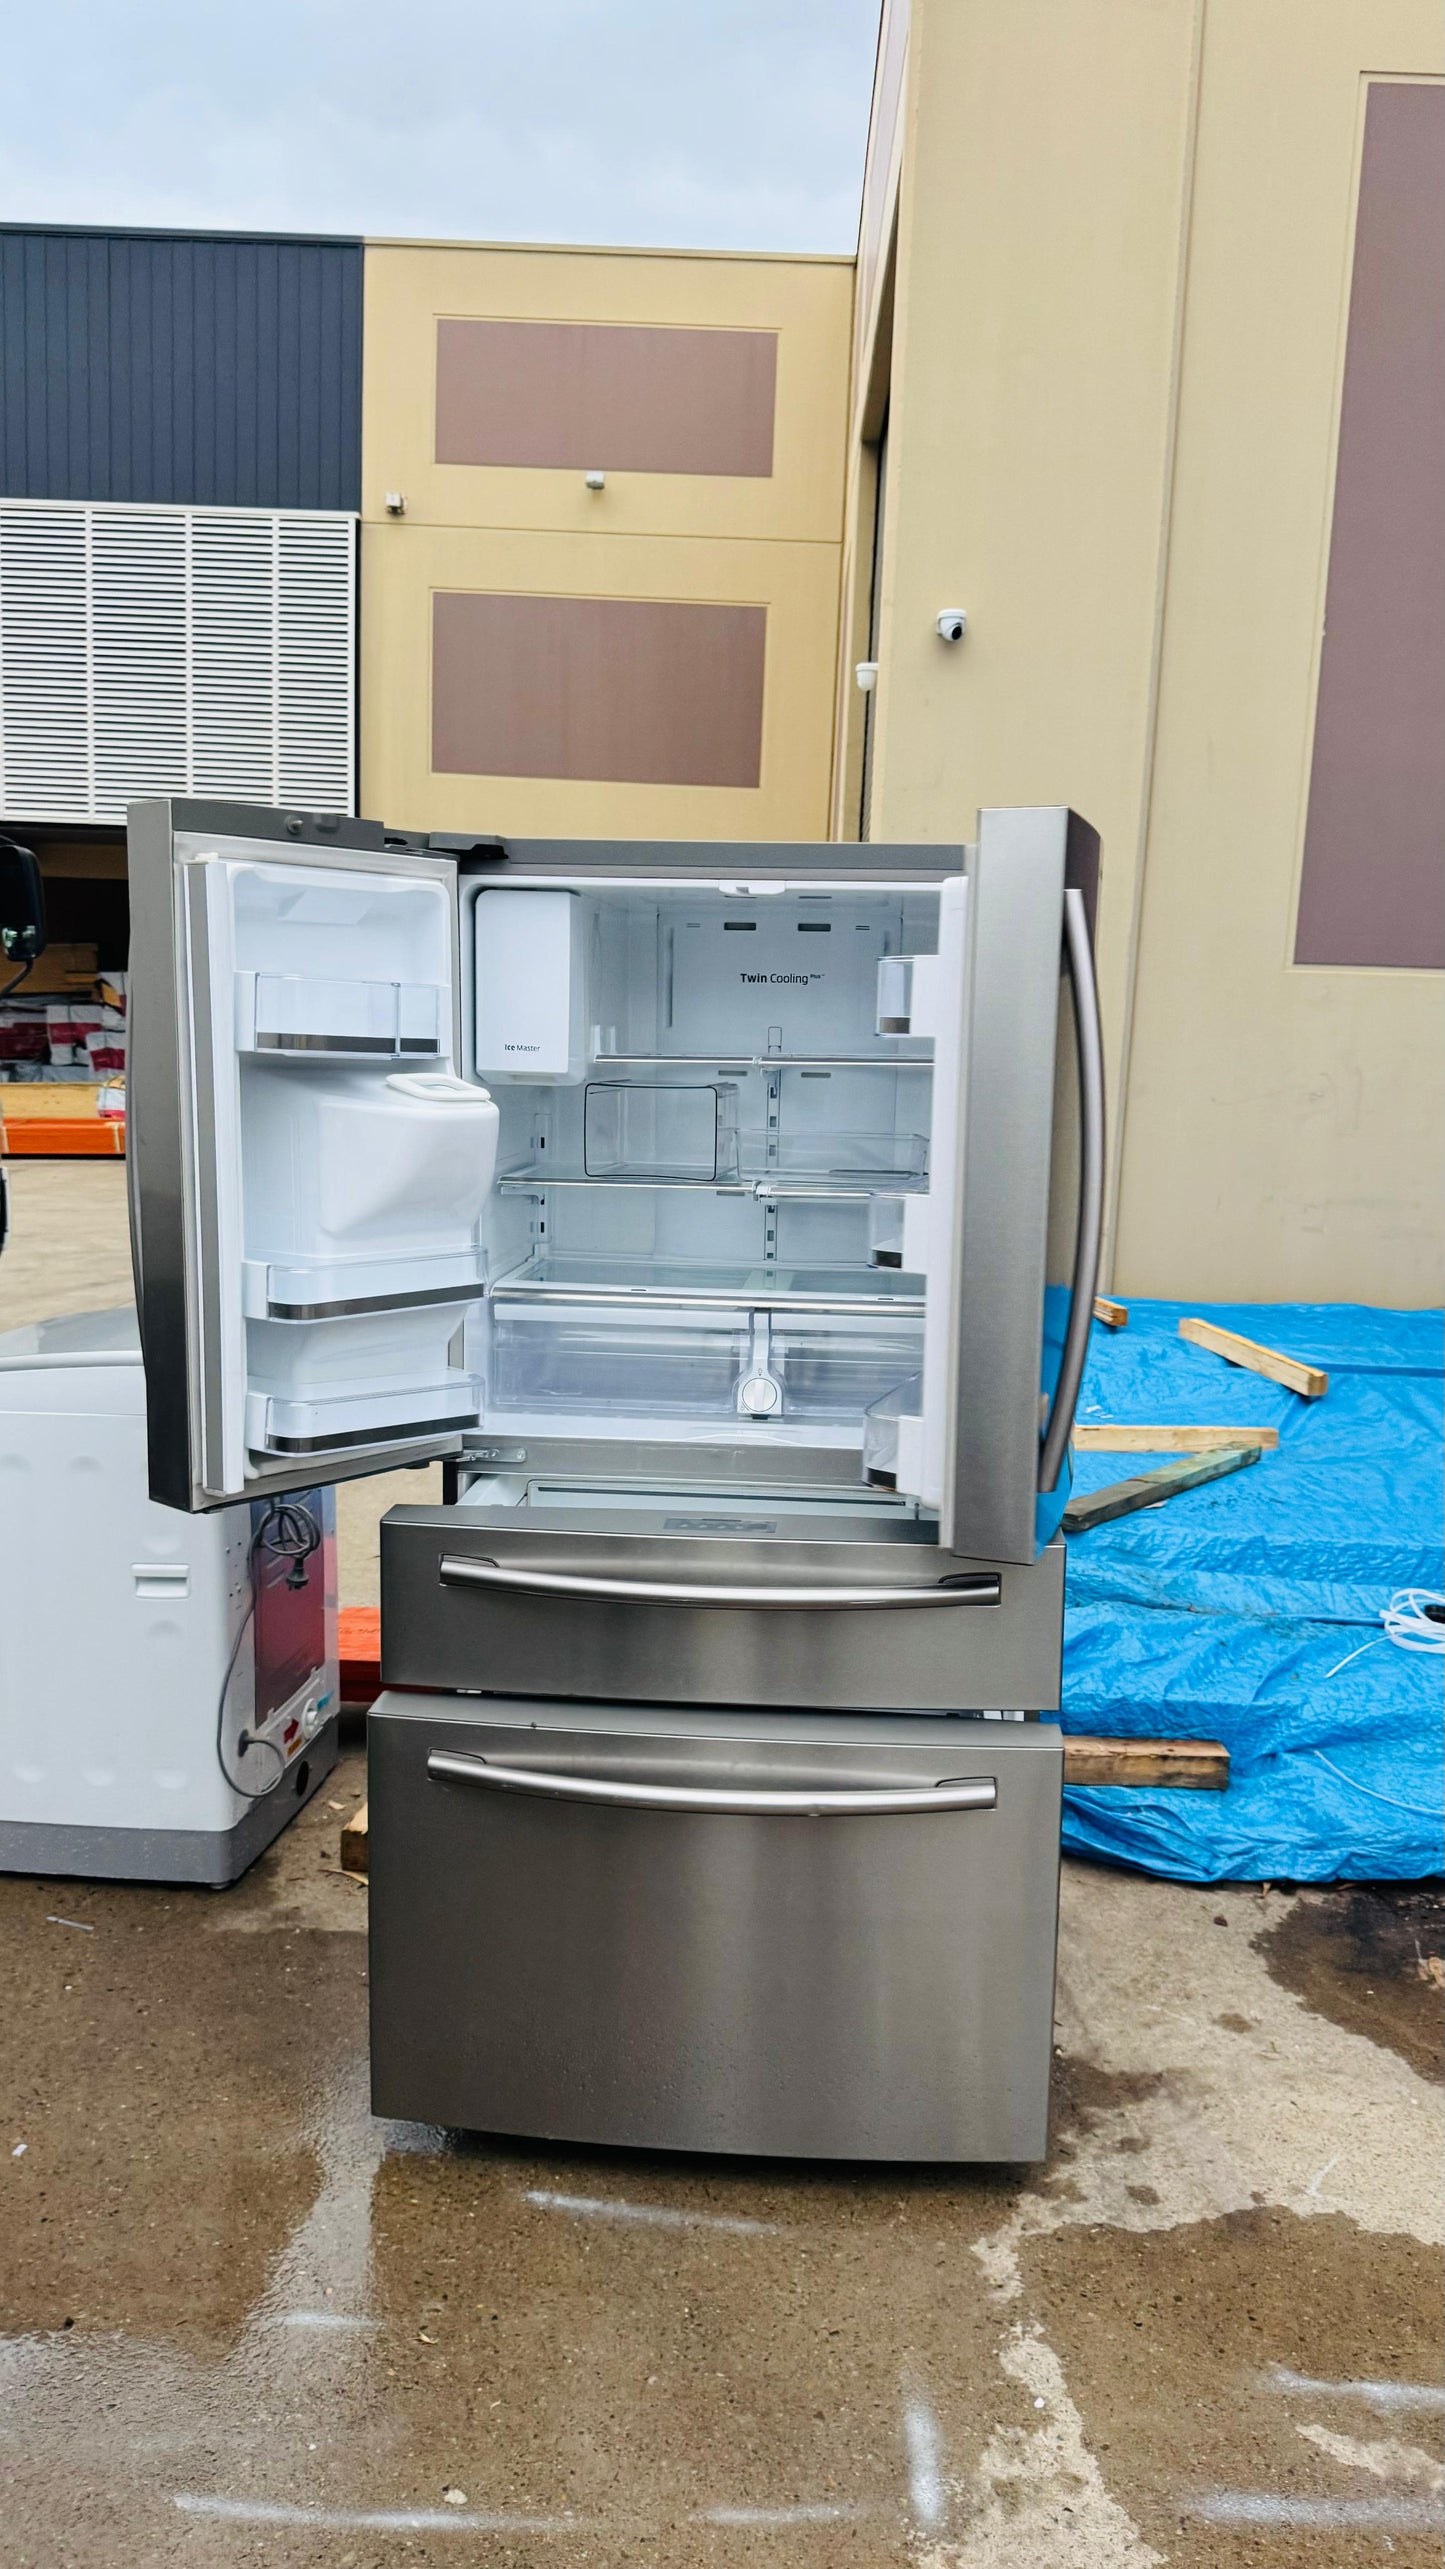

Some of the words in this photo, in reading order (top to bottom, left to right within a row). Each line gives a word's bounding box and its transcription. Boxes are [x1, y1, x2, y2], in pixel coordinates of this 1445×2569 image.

[740, 973, 768, 983] Twin
[770, 973, 809, 986] Cooling
[516, 1044, 541, 1052] Master
